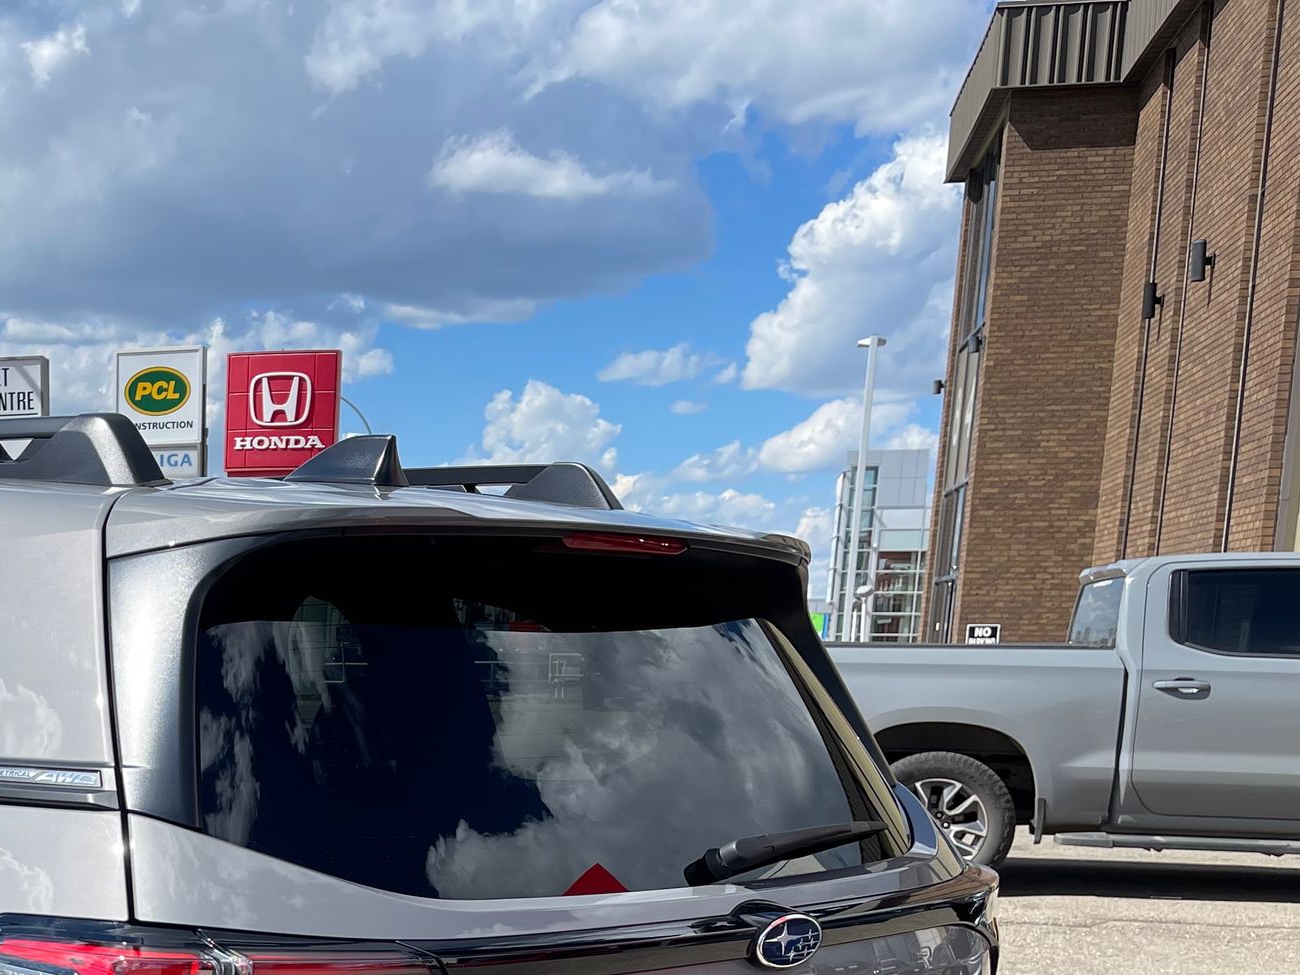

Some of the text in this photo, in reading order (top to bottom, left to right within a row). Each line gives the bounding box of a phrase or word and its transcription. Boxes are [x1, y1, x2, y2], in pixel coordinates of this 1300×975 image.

[134, 380, 180, 401] PCL
[135, 420, 194, 430] NSTRUCTION
[233, 435, 326, 450] HONDA
[974, 626, 992, 638] NO
[34, 771, 97, 785] AWD
